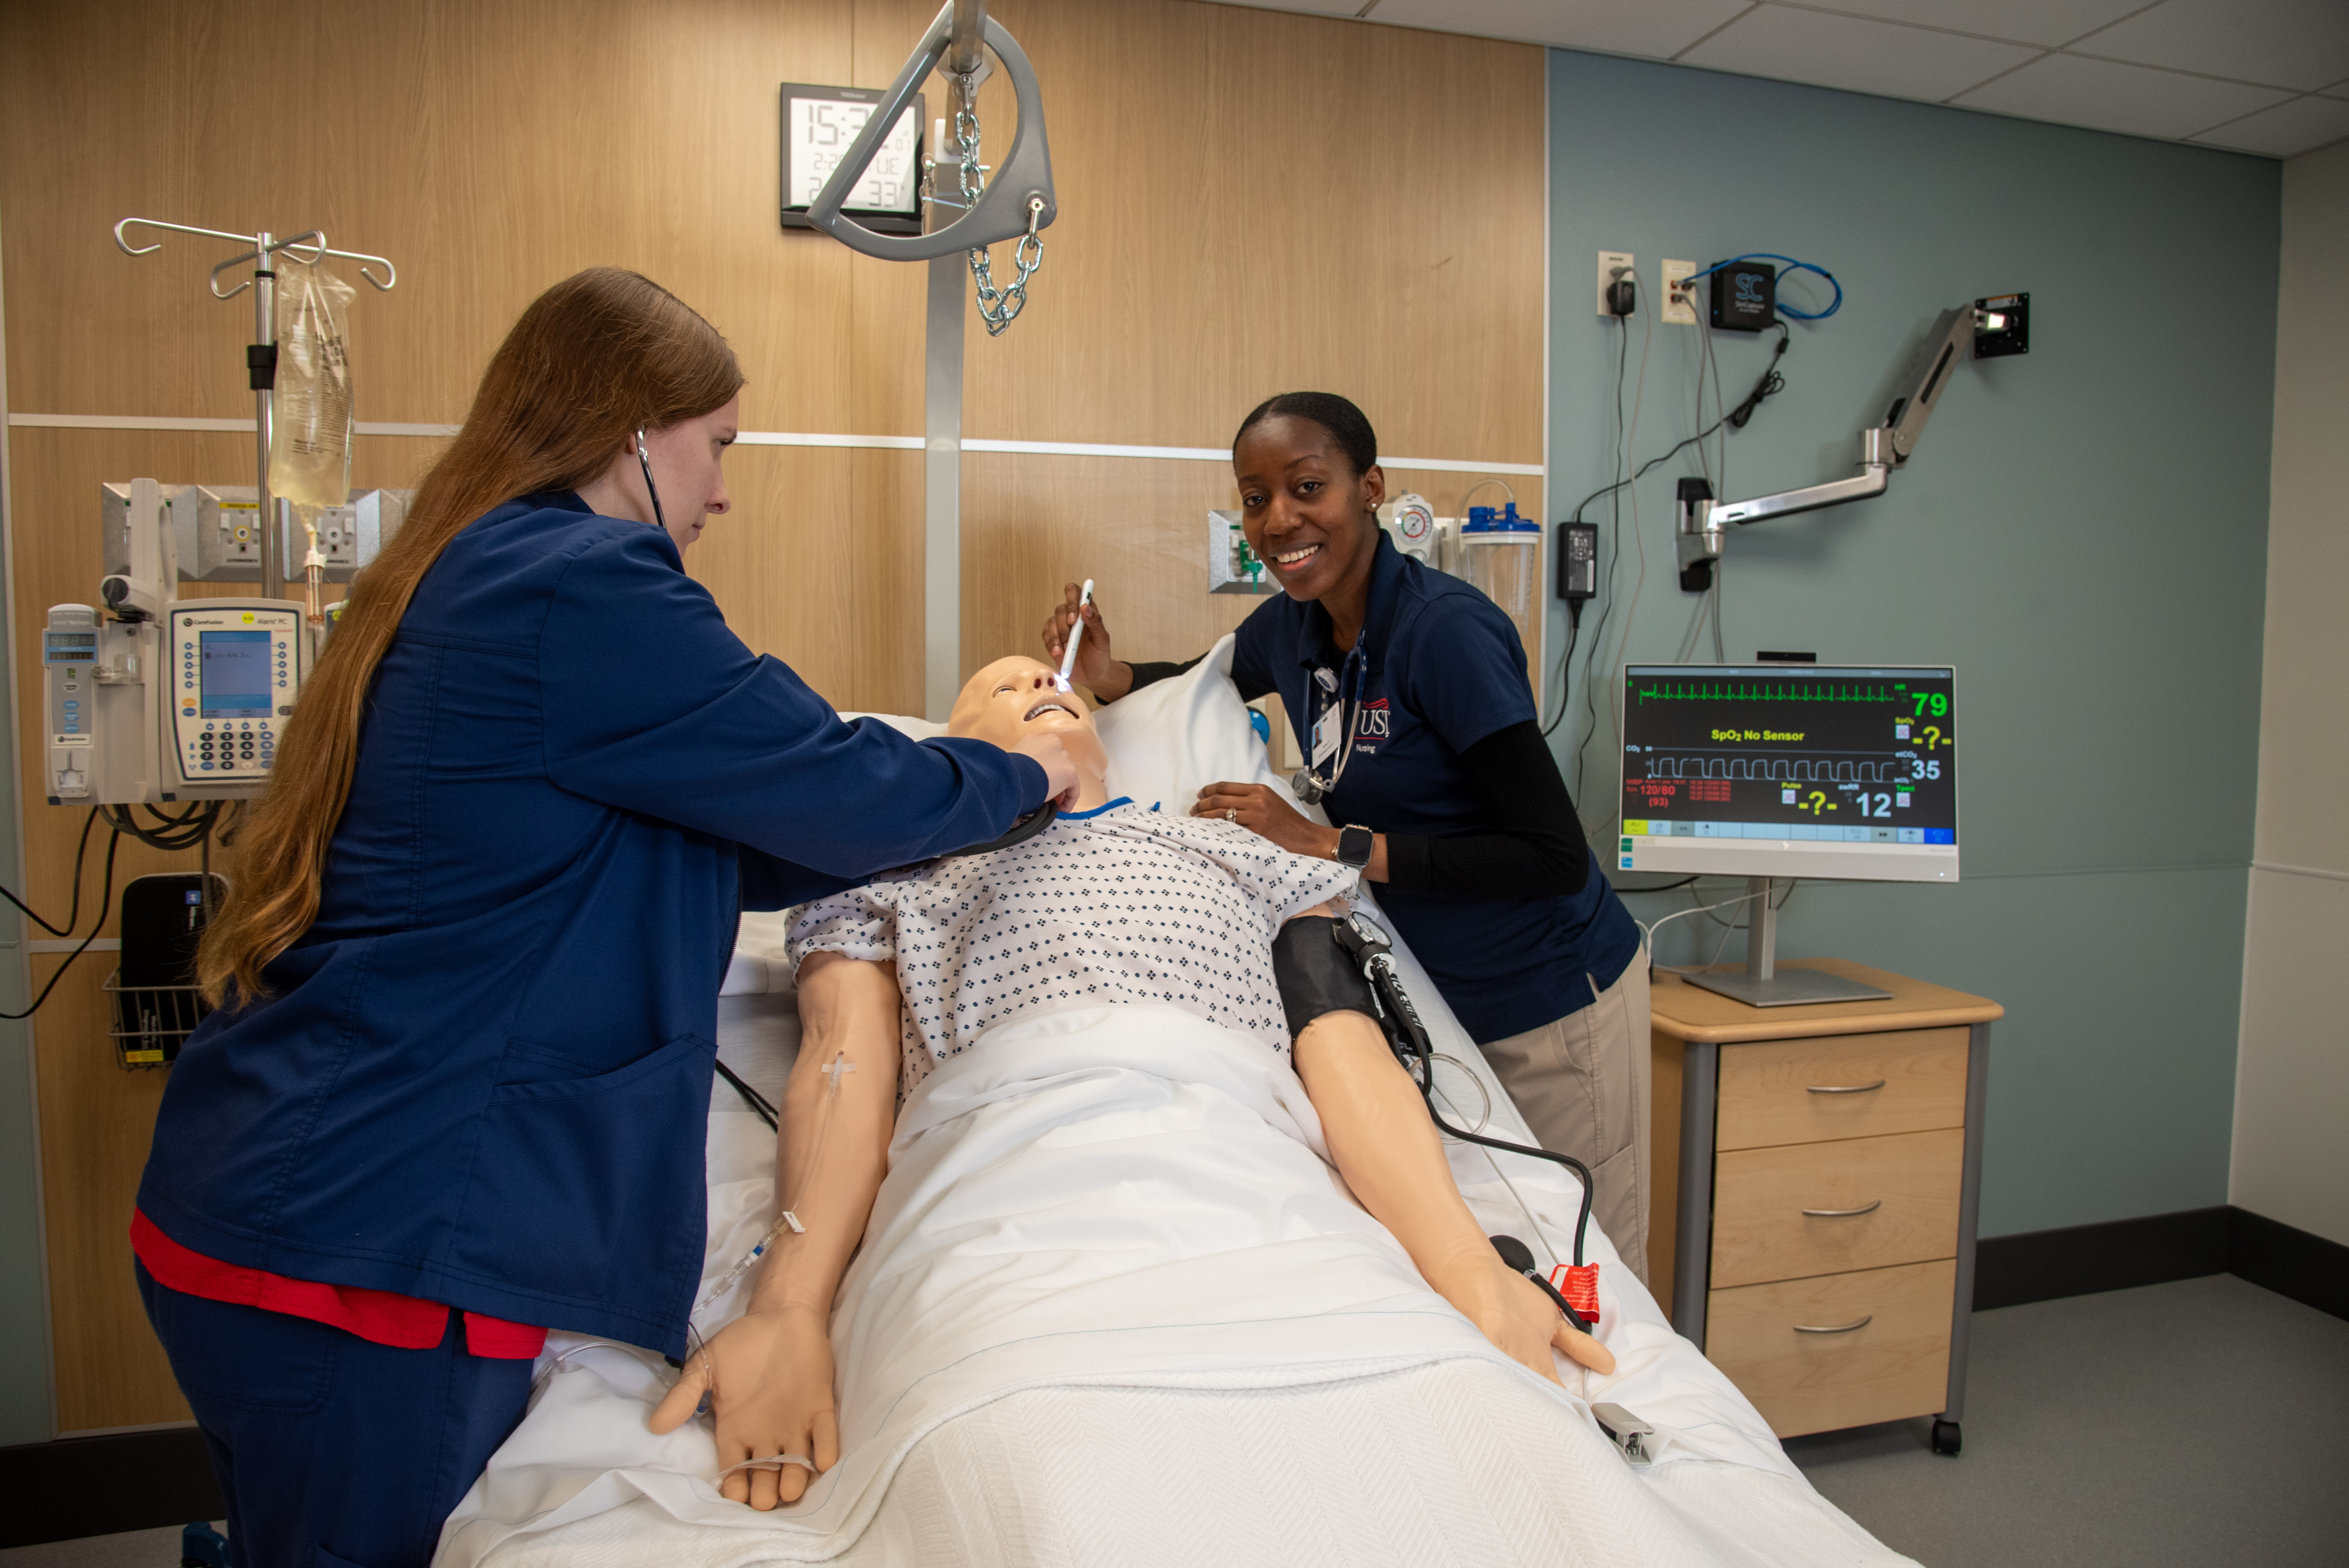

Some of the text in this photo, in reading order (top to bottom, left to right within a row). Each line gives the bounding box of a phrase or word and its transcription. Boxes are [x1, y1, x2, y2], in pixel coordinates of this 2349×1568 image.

[1912, 692, 1948, 717] 79
[1744, 730, 1761, 740] No
[1763, 730, 1805, 741] Sensor
[1356, 743, 1376, 754] Nursing
[1912, 759, 1941, 780] 35
[1640, 784, 1676, 796] 120/80
[1649, 797, 1669, 808] (93)
[1856, 792, 1891, 817] 12
